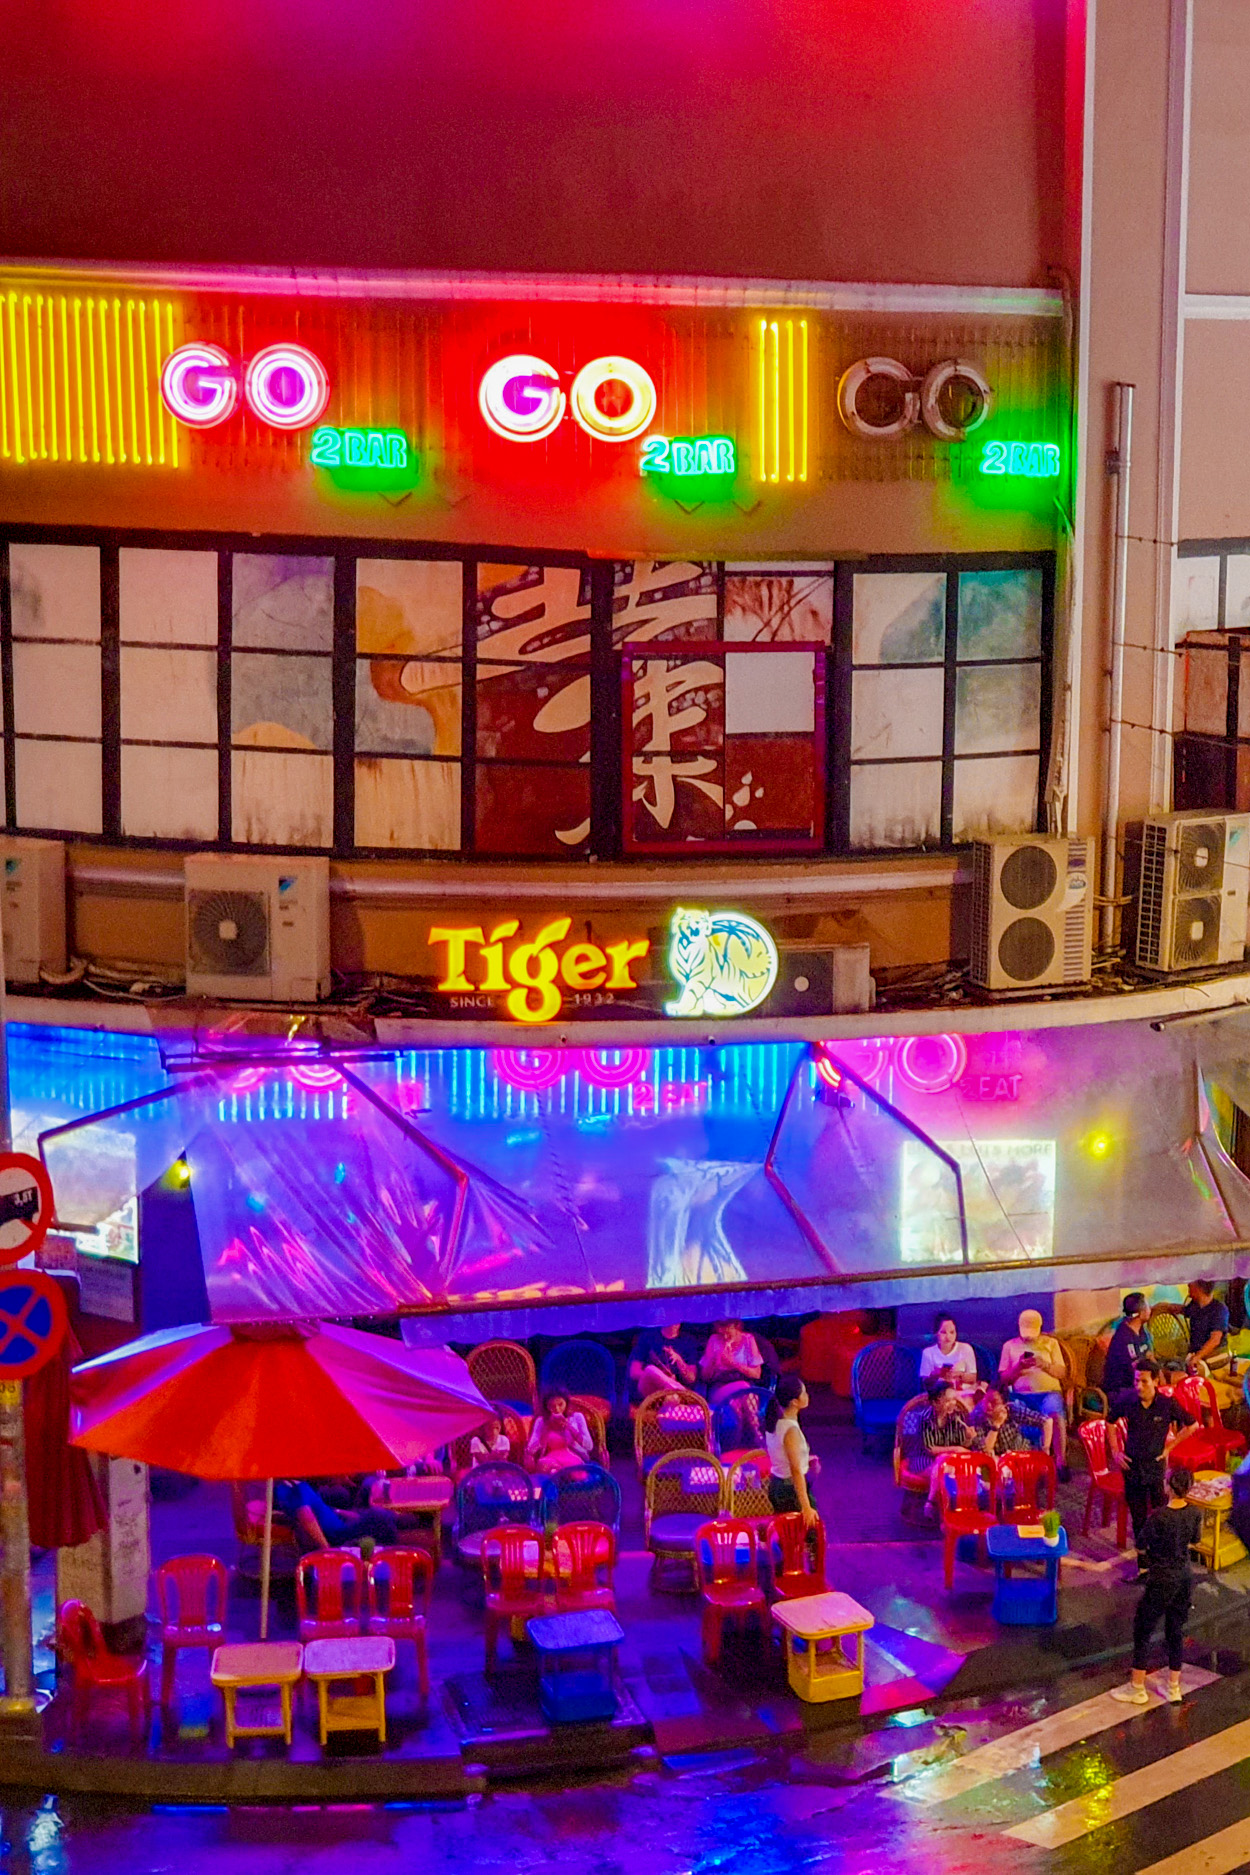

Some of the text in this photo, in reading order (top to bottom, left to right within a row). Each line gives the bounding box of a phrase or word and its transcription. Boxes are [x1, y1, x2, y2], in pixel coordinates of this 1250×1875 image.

[159, 341, 330, 430] GO
[478, 354, 657, 443] GO
[344, 430, 408, 468] BAR
[671, 438, 736, 475] BAR
[428, 917, 650, 1023] Tiger
